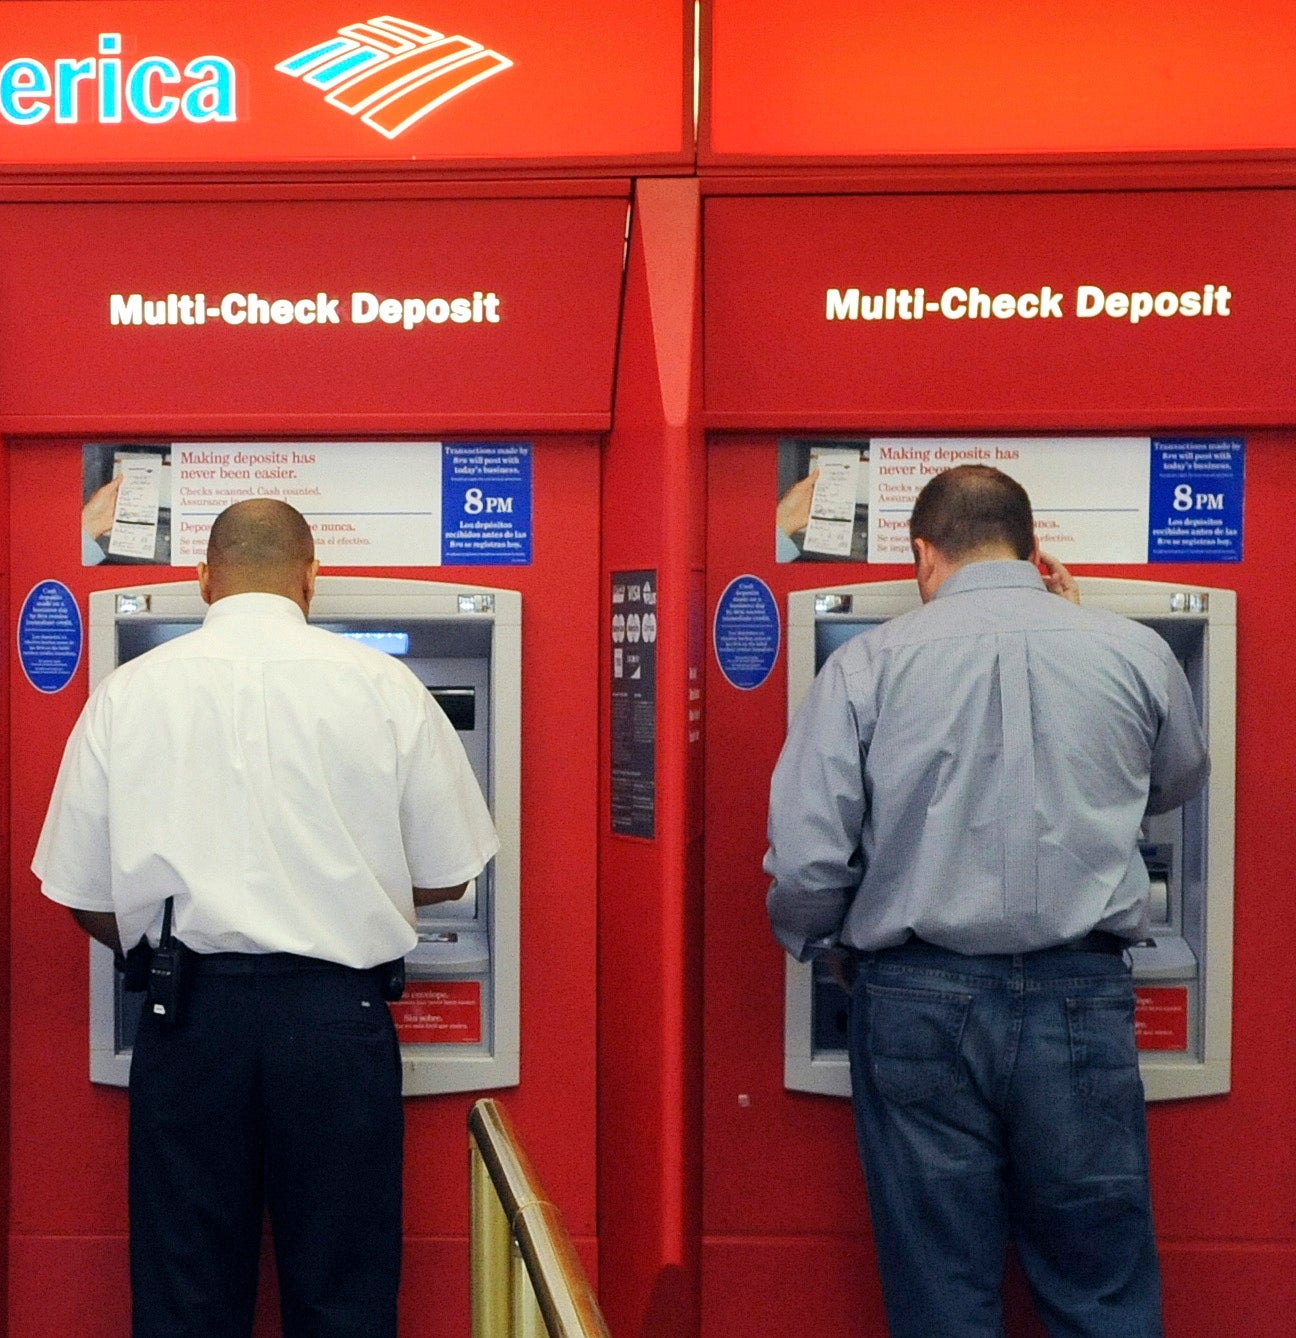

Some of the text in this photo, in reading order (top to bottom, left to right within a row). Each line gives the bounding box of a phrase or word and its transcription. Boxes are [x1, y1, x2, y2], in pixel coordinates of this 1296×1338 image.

[826, 285, 1232, 323] Multi-Check Deposit
[109, 292, 500, 330] Multi-Check Deposit
[181, 452, 316, 466] Making deposits has
[469, 456, 483, 464] will
[880, 447, 1019, 461] Making deposits has
[181, 467, 297, 479] never been easier.
[880, 466, 915, 475] never
[180, 487, 212, 496] Checks
[257, 487, 280, 495] Cash
[879, 483, 912, 492] Checks
[181, 498, 227, 506] Assurance
[464, 488, 513, 515] 8 PM
[1173, 484, 1224, 512] 8 PM
